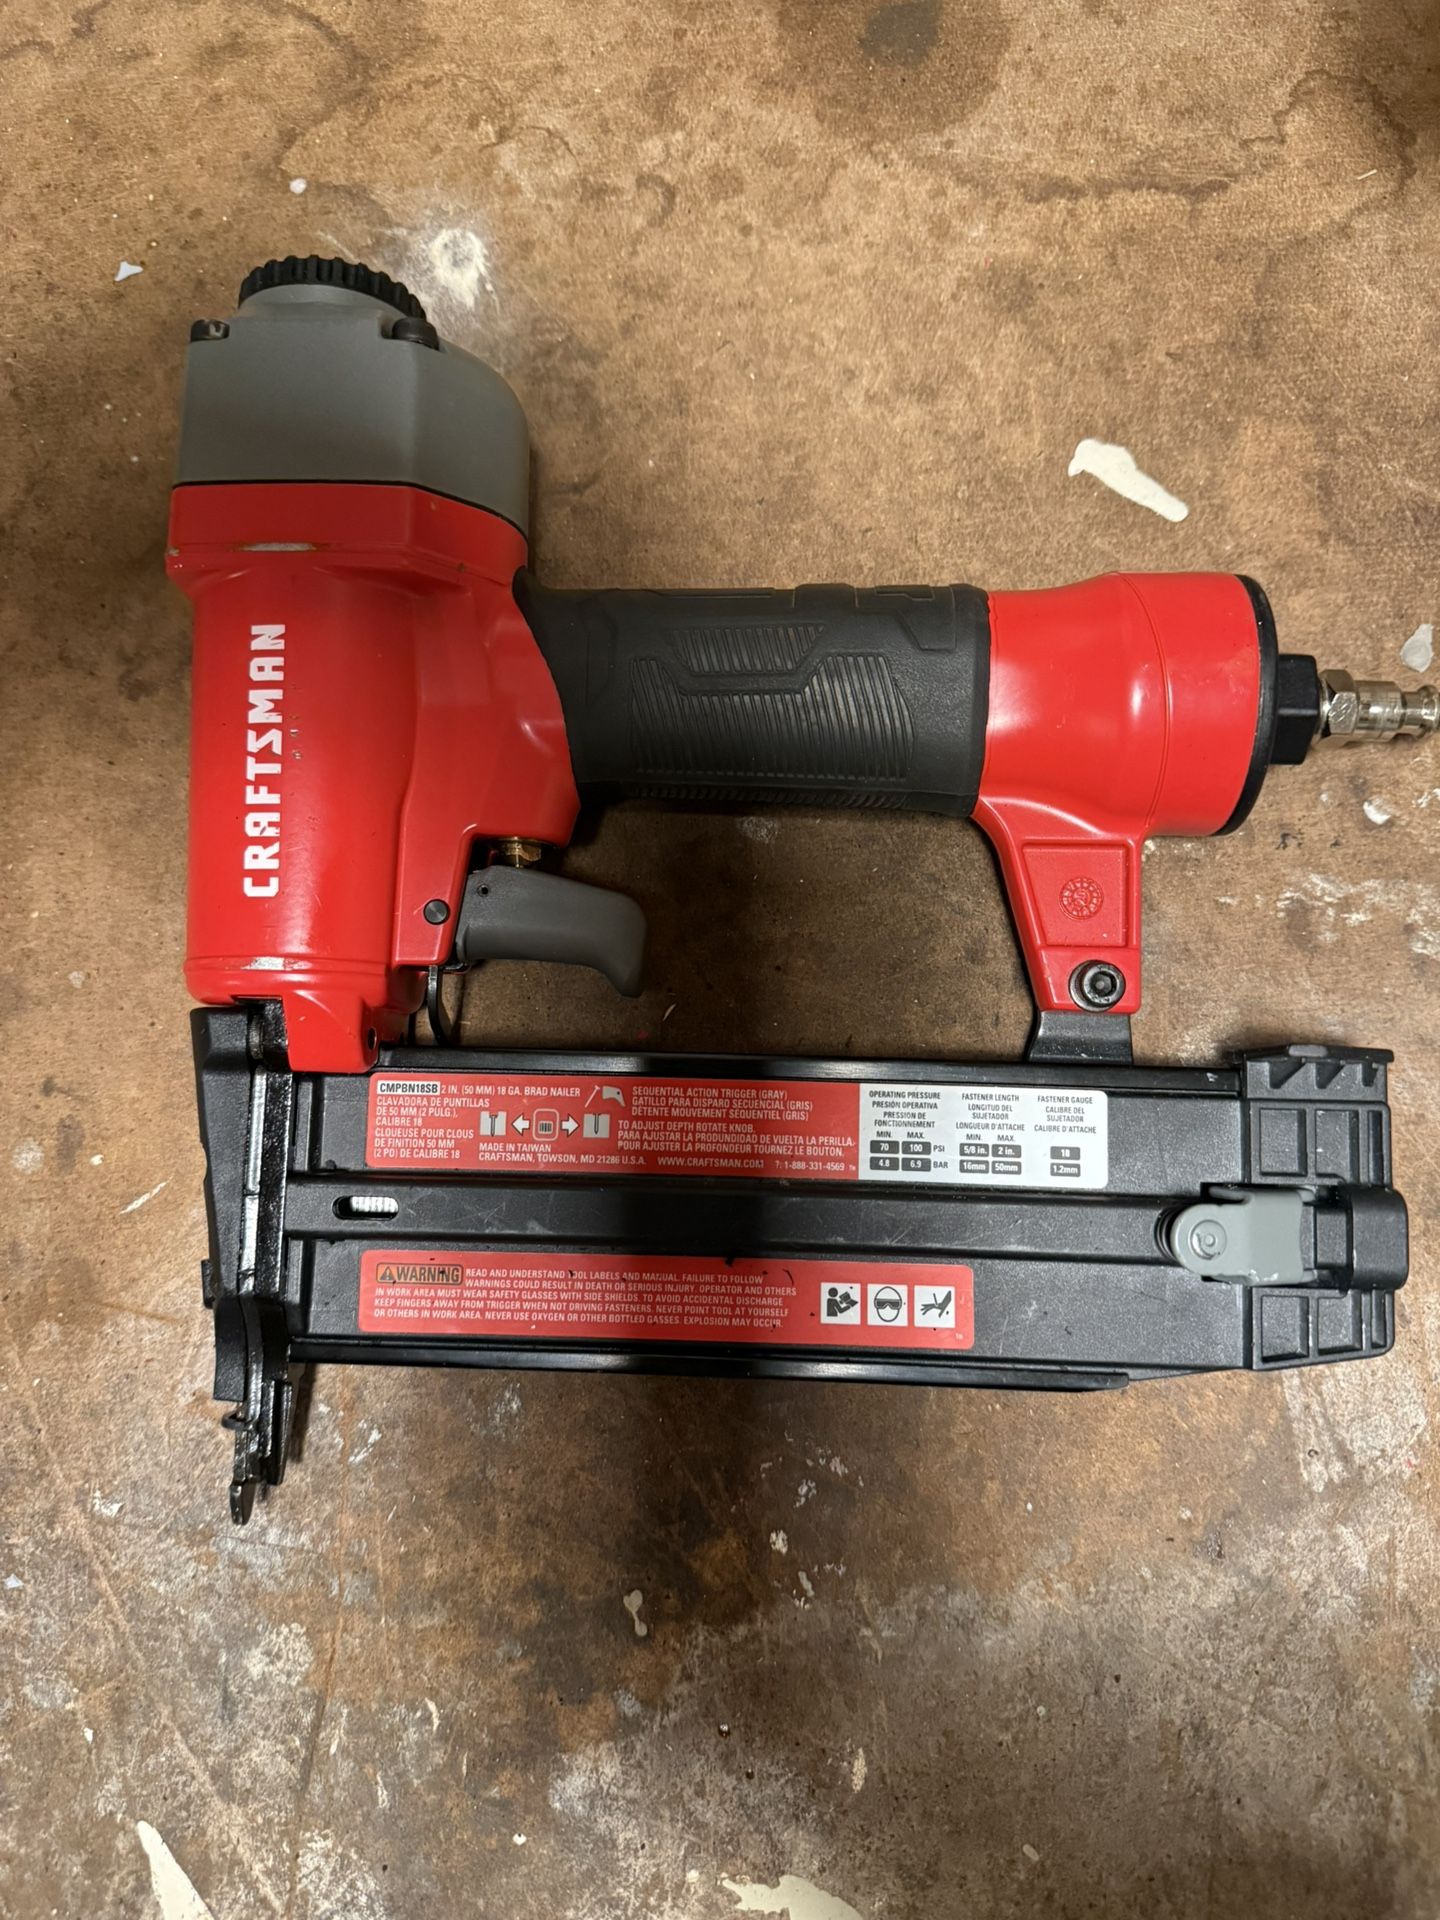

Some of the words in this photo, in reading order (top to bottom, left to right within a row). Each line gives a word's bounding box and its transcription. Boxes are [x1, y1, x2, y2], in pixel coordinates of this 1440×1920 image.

[243, 624, 286, 898] CRAFTSMAN
[380, 1083, 438, 1094] CMPBN18SB
[442, 1085, 446, 1094] 2
[448, 1085, 458, 1094] IN.
[462, 1085, 474, 1095] (50
[475, 1086, 495, 1095] MM)
[498, 1086, 506, 1095] 18
[508, 1086, 522, 1096] GA.
[524, 1087, 548, 1096] BRAD
[550, 1087, 580, 1097] NAILER
[632, 1087, 684, 1097] SEQUENTIAL
[686, 1088, 719, 1098] ACTION
[721, 1089, 757, 1098] TRIGGER
[759, 1090, 788, 1099] (GRAY)
[907, 1091, 941, 1099] PRESSURE
[377, 1097, 428, 1106] CLAVADORA
[430, 1098, 441, 1107] DE
[443, 1098, 490, 1107] PUNTILLAS
[632, 1097, 666, 1106] GATILLO
[668, 1098, 691, 1107] PARA
[693, 1098, 730, 1108] DISPARO
[732, 1099, 785, 1109] SECUENCIAL
[787, 1100, 813, 1110] (GRIS)
[1038, 1096, 1070, 1104] FASTENER
[902, 1102, 938, 1110] OPERATIVA
[376, 1108, 387, 1116] DE
[388, 1108, 399, 1116] 50
[400, 1108, 417, 1116] MM
[418, 1108, 427, 1116] (2
[428, 1108, 458, 1117] PULG.),
[671, 1108, 727, 1118] MOUVEMENT
[782, 1111, 809, 1121] (GRIS)
[376, 1118, 411, 1126] CALIBRE
[413, 1118, 423, 1126] 18
[875, 1120, 935, 1128] FONCTIONNEMENT
[618, 1121, 630, 1129] TO
[631, 1121, 664, 1130] ADJUST
[667, 1122, 694, 1131] DEPTH
[696, 1123, 727, 1132] ROTATE
[729, 1123, 756, 1133] KNOB.
[1034, 1125, 1060, 1133] CALIBRE
[1062, 1126, 1097, 1134] D'ATTACHE
[375, 1129, 419, 1138] CLOUEUSE
[421, 1130, 445, 1138] POUR
[446, 1130, 474, 1138] CLOUS
[618, 1132, 641, 1140] PARA
[642, 1133, 681, 1141] AJUSTAR
[760, 1135, 771, 1144] DE
[773, 1136, 804, 1145] VUELTA
[806, 1136, 817, 1145] LA
[375, 1139, 386, 1147] DE
[388, 1139, 425, 1148] FINITION
[427, 1140, 436, 1148] 50
[438, 1140, 455, 1148] MM
[479, 1143, 504, 1151] MADE
[506, 1143, 515, 1151] IN
[517, 1144, 552, 1152] TAIWAN
[880, 1144, 889, 1152] 70
[618, 1141, 641, 1150] POUR
[643, 1142, 681, 1151] AJUSTER
[682, 1143, 693, 1152] LA
[695, 1143, 752, 1153] PROFONDEUR
[754, 1145, 793, 1154] TOURNEZ
[795, 1146, 804, 1155] LE
[806, 1146, 844, 1156] BOUTON.
[933, 1145, 945, 1153] PSI
[964, 1146, 976, 1155] 5/8
[977, 1146, 987, 1155] in.
[998, 1147, 1003, 1155] 2
[1005, 1147, 1015, 1155] in.
[374, 1149, 382, 1158] (2
[383, 1149, 398, 1158] PO)
[400, 1149, 411, 1158] DE
[413, 1149, 449, 1158] CALIBRE
[451, 1150, 460, 1158] 18
[479, 1153, 536, 1162] CRAFTSMAN,
[537, 1155, 578, 1163] TOWSON,
[580, 1156, 595, 1164] MD
[658, 1157, 764, 1168] WWW.CRAFTSMAN.COM
[963, 1163, 986, 1171] 16mm
[995, 1163, 1018, 1172] 50mm
[1053, 1166, 1078, 1174] 1.2mm
[397, 1267, 459, 1282] WARNING
[465, 1280, 511, 1288] WARNINGS
[513, 1281, 540, 1289] COULD
[542, 1282, 572, 1290] RESULT
[574, 1282, 583, 1290] IN
[585, 1283, 613, 1291] DEATH
[614, 1283, 626, 1291] OR
[628, 1284, 663, 1292] SERIOUS
[665, 1285, 697, 1293] INJURY.
[699, 1285, 743, 1294] OPERATOR
[744, 1286, 763, 1295] AND
[764, 1287, 797, 1296] OTHERS
[375, 1288, 385, 1296] IN
[386, 1289, 411, 1297] WORK
[413, 1289, 435, 1297] AREA
[437, 1290, 461, 1298] MUST
[463, 1290, 487, 1298] WEAR
[489, 1291, 519, 1299] SAFETY
[521, 1292, 558, 1300] GLASSES
[560, 1293, 582, 1301] WITH
[584, 1293, 602, 1301] SIDE
[604, 1294, 639, 1302] SHIELDS.
[643, 1294, 653, 1302] TO
[655, 1295, 681, 1303] AVOID
[683, 1295, 734, 1304] ACCIDENTAL
[736, 1297, 783, 1305] DISCHARGE
[374, 1299, 395, 1307] KEEP
[396, 1300, 432, 1308] FINGERS
[432, 1300, 459, 1309] AWAY
[461, 1301, 484, 1309] FROM
[487, 1302, 521, 1310] TRIGGER
[522, 1303, 548, 1311] WHEN
[550, 1303, 566, 1311] NOT
[569, 1304, 603, 1312] DRIVING
[605, 1304, 652, 1313] FASTENERS.
[656, 1306, 683, 1314] NEVER
[684, 1306, 709, 1315] POINT
[712, 1307, 732, 1315] TOOL
[734, 1307, 746, 1315] AT
[748, 1308, 789, 1316] YOURSELF
